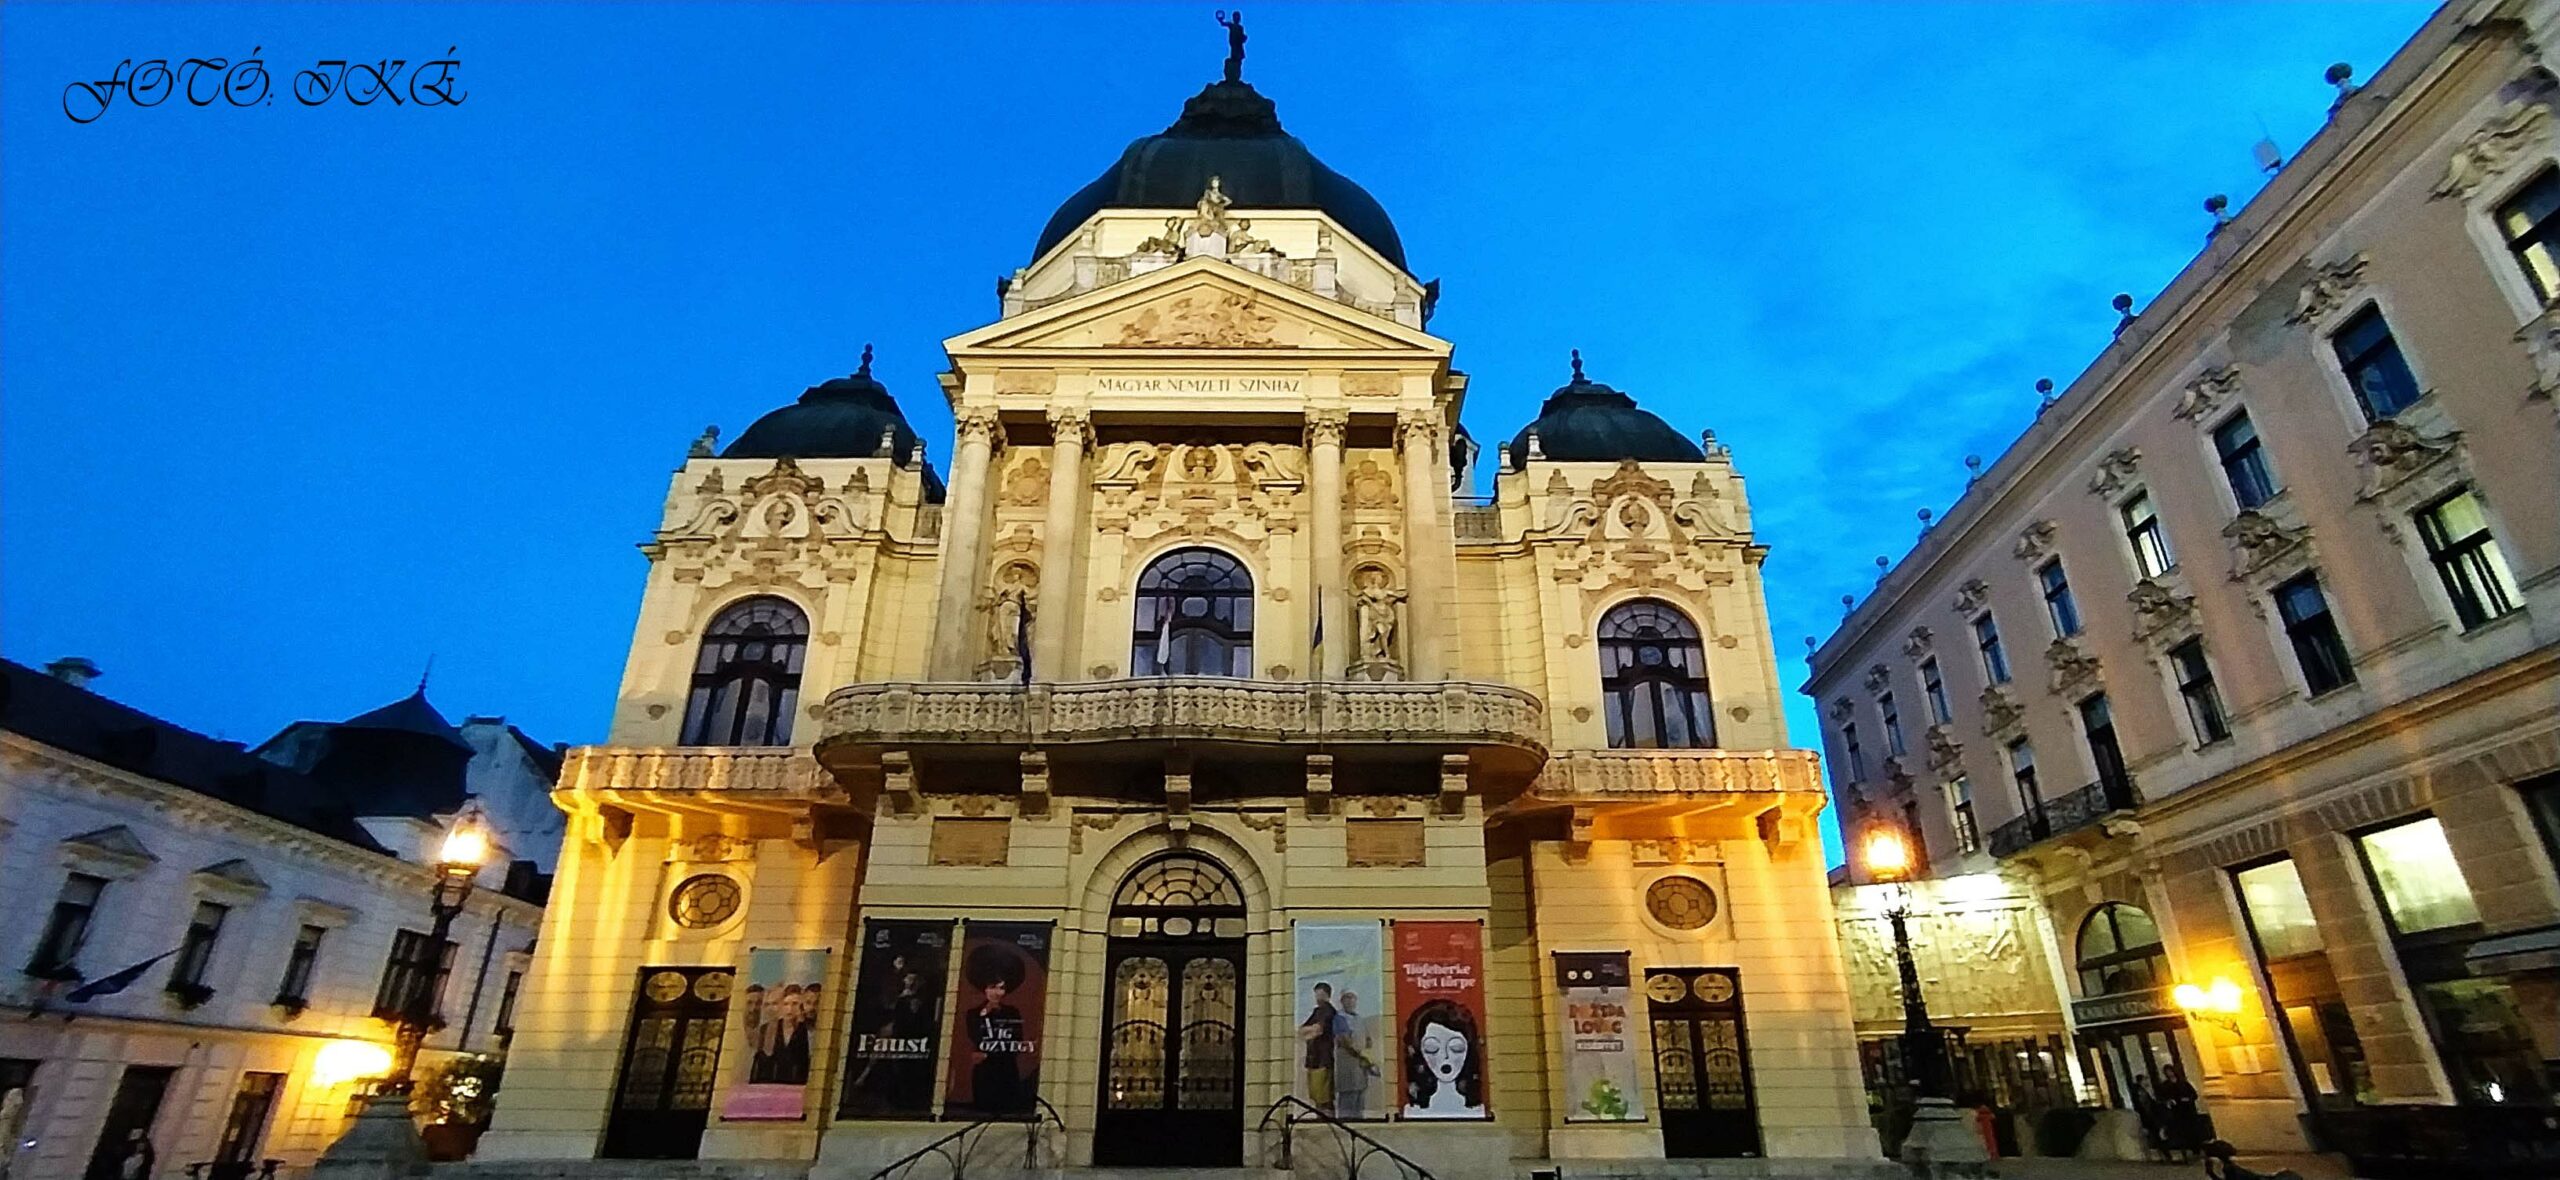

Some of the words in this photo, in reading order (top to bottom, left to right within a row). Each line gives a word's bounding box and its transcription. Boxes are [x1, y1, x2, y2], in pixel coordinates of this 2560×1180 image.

[1098, 379, 1162, 391] MAGYAR
[1167, 379, 1230, 391] NEMZETI
[858, 1034, 930, 1052] Faust
